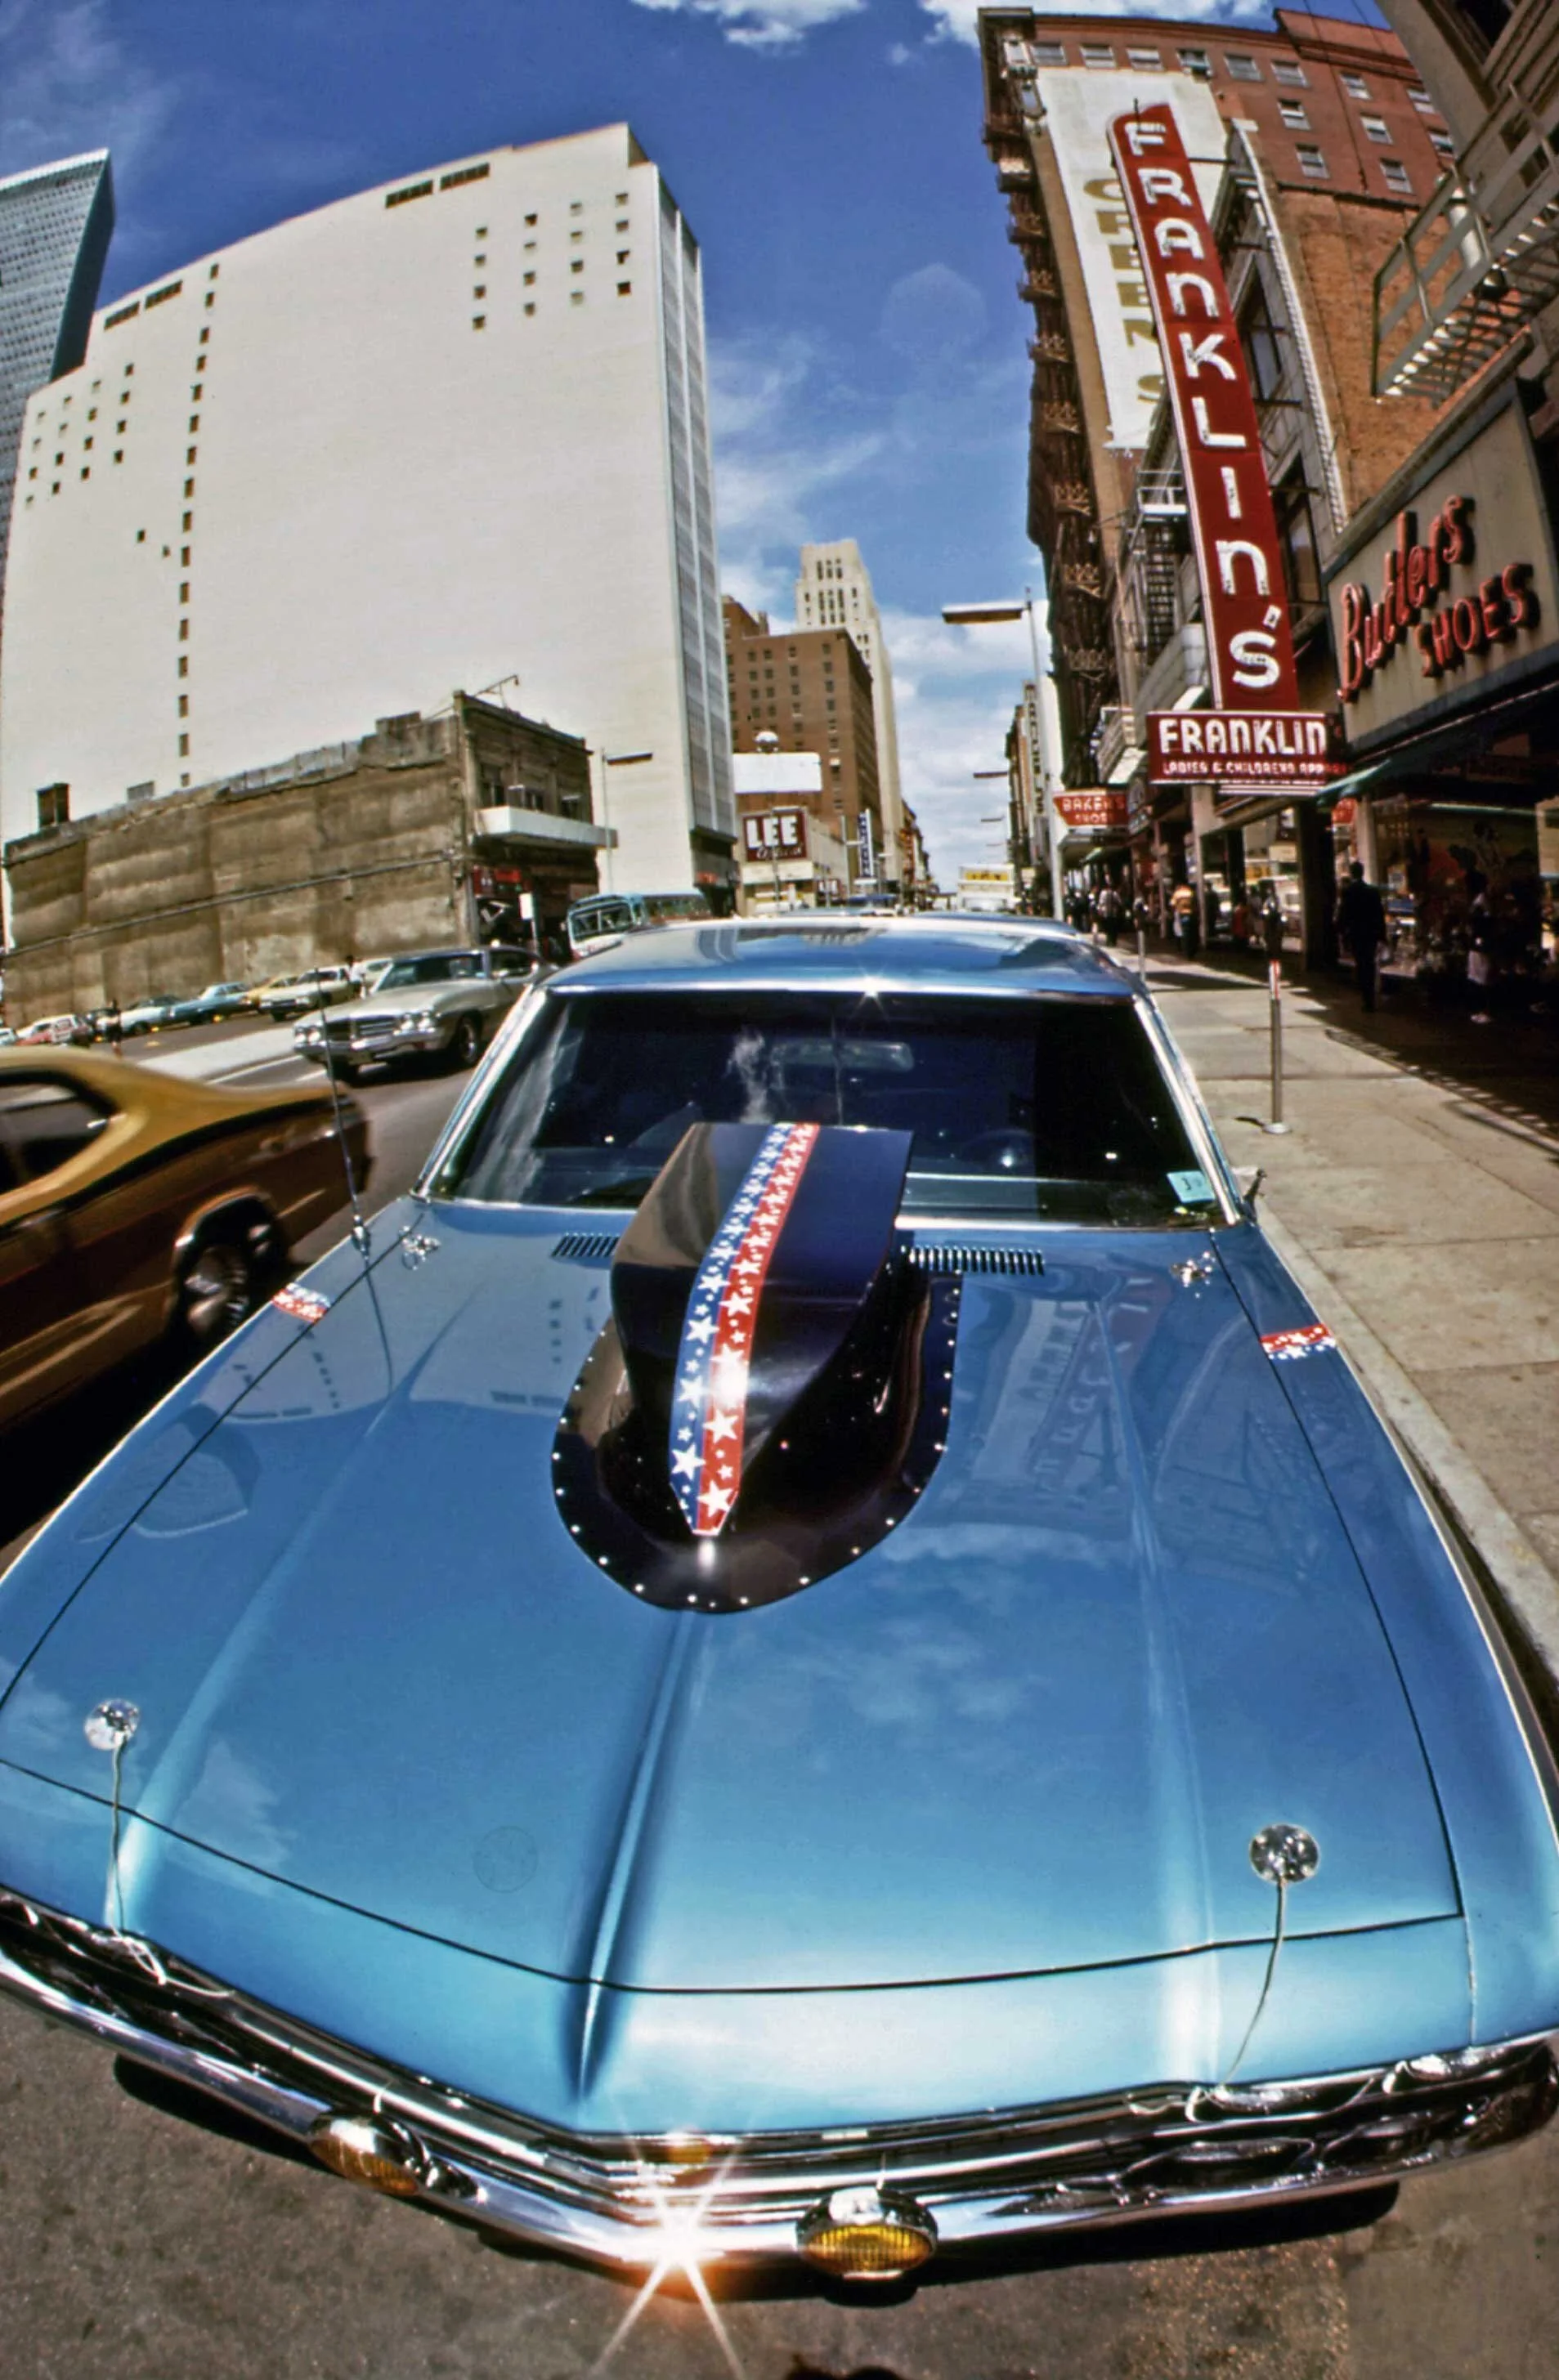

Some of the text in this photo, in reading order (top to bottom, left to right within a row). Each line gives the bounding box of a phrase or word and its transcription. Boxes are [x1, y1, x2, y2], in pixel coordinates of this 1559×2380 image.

[1413, 562, 1530, 678] SHOES
[1158, 718, 1327, 755] FRANKLIN
[1163, 760, 1208, 775] LADIES
[1212, 760, 1224, 774] &
[746, 815, 799, 848] LEE
